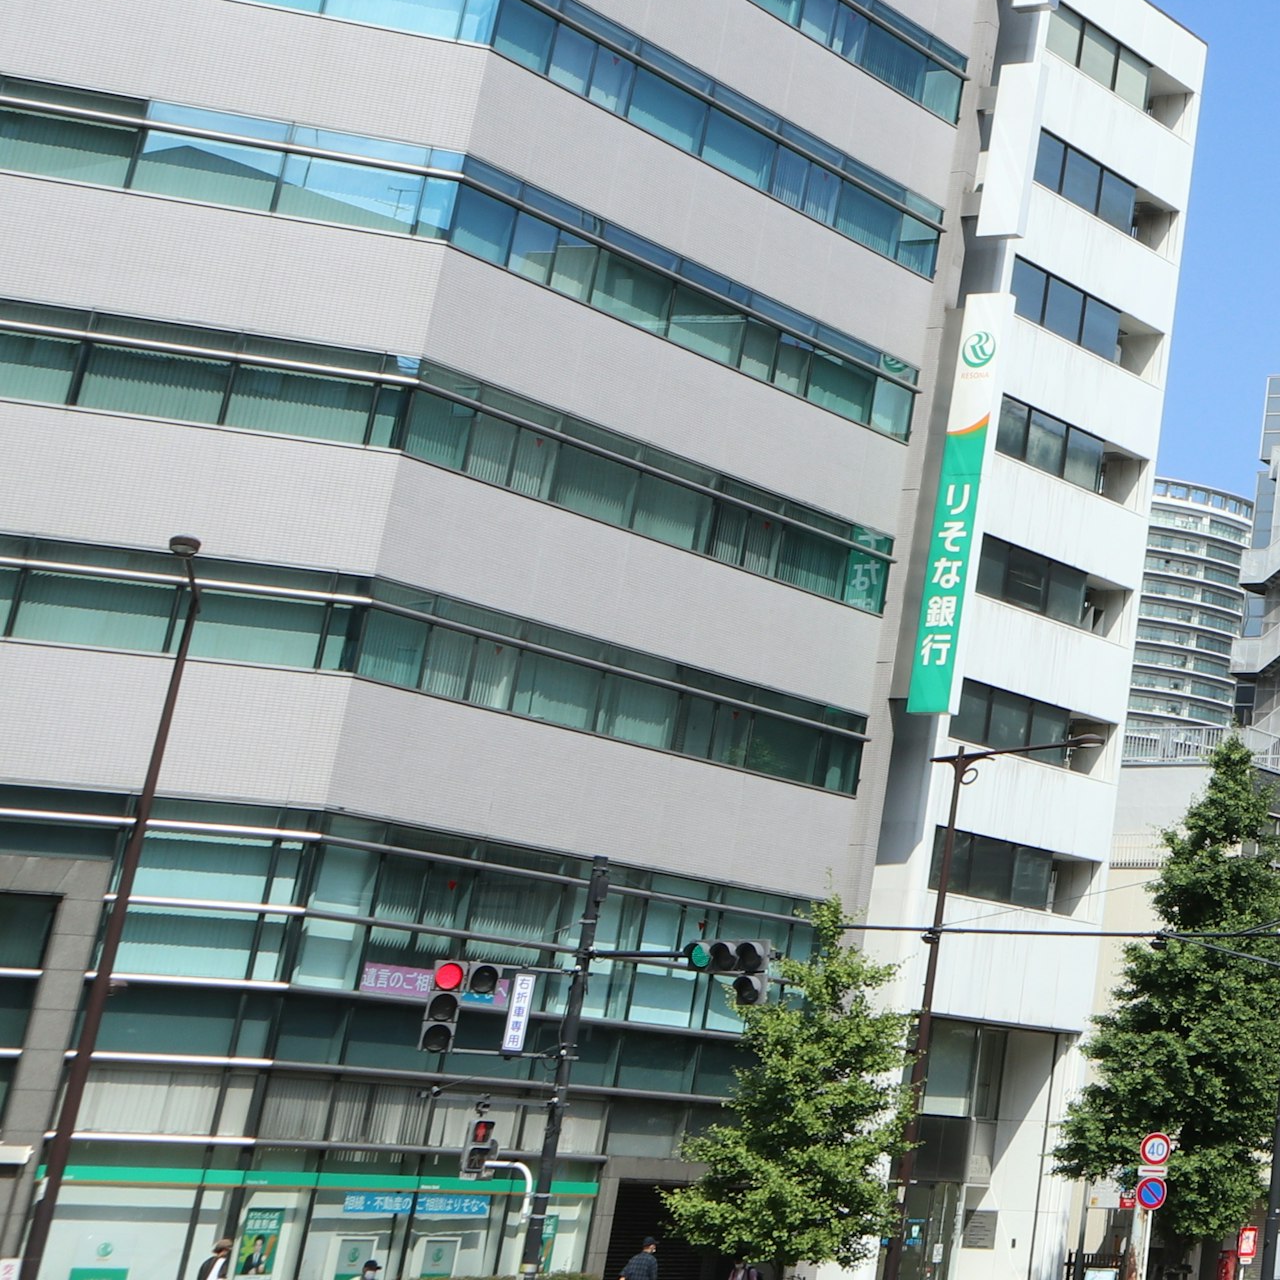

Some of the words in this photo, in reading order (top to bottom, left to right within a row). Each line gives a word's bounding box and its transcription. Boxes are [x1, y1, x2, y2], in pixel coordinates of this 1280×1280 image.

[961, 371, 990, 380] RESONA
[921, 484, 970, 666] りそな銀行
[507, 978, 530, 1047] 右折車専用
[1148, 1142, 1165, 1156] 40
[344, 1194, 411, 1212] 相続・不動産の
[416, 1197, 488, 1213] ご相談はりそなへ
